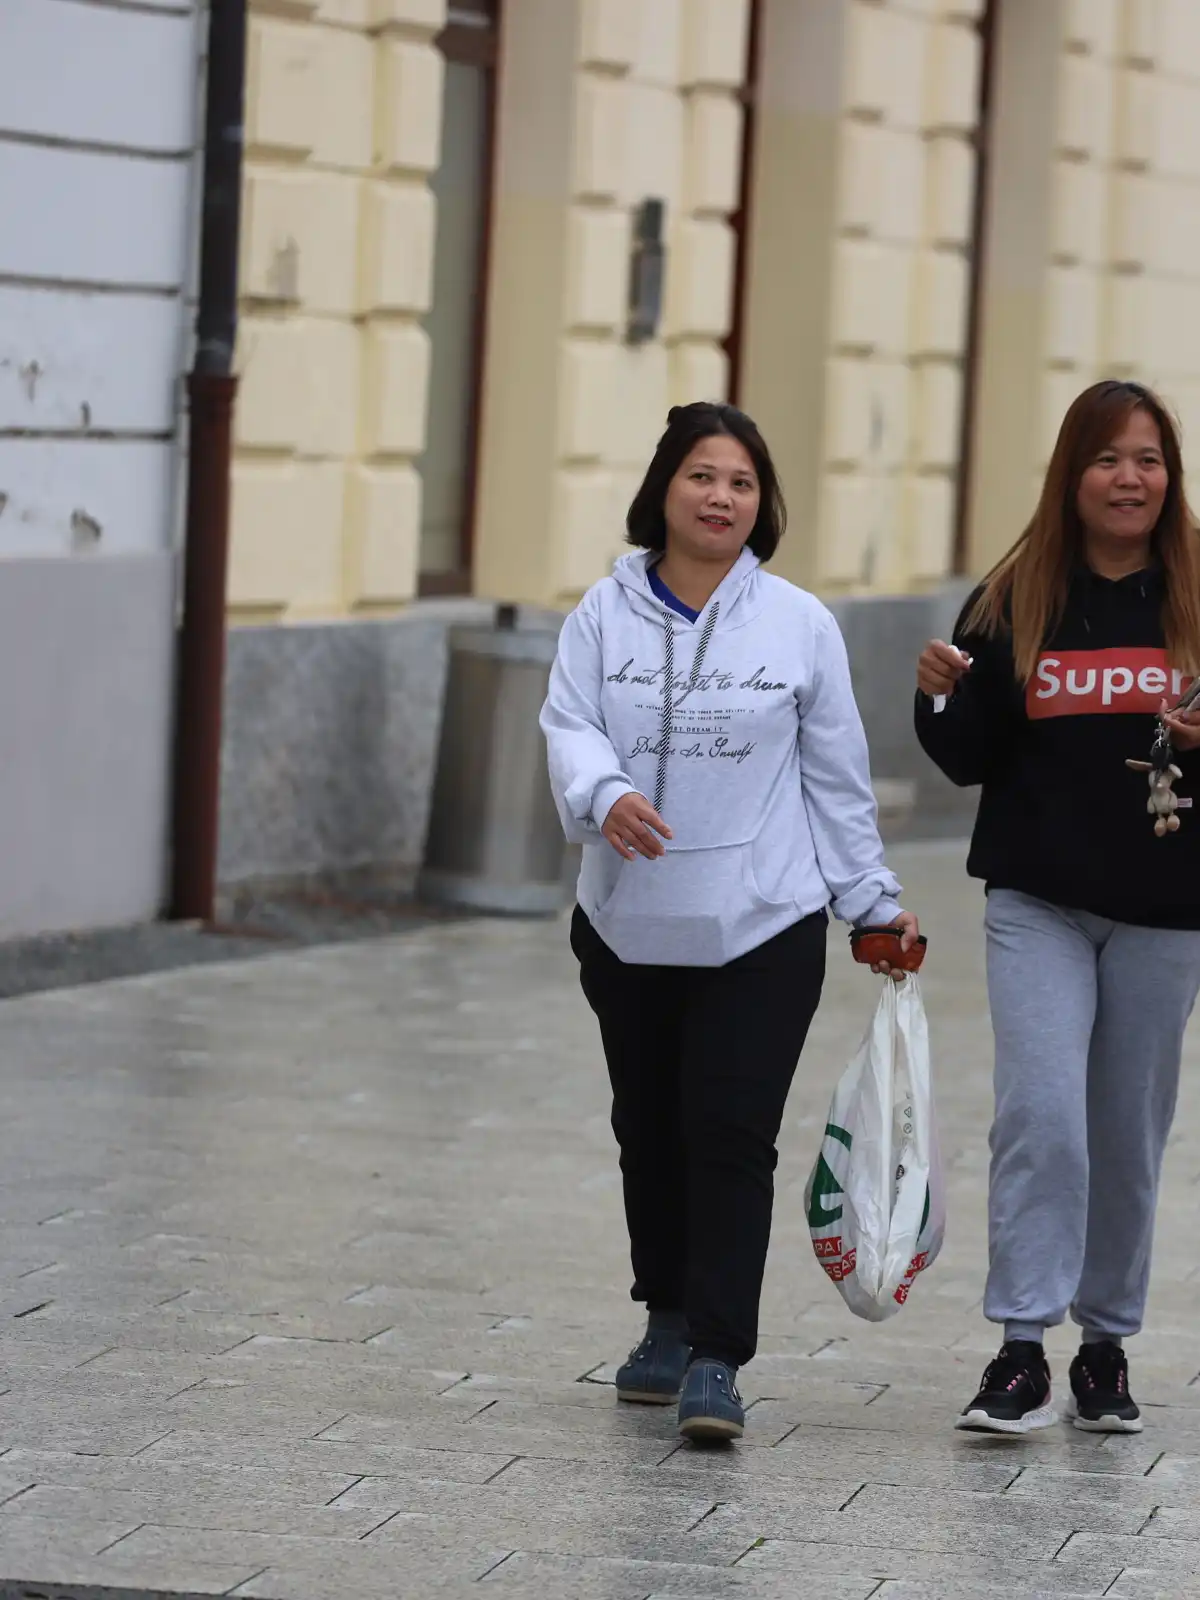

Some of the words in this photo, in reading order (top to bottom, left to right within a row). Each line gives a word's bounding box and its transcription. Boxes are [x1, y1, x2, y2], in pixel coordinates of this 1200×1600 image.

[607, 658, 634, 684] do
[630, 666, 666, 685] not
[716, 672, 735, 690] to
[739, 666, 788, 692] dream
[1035, 658, 1182, 705] Super
